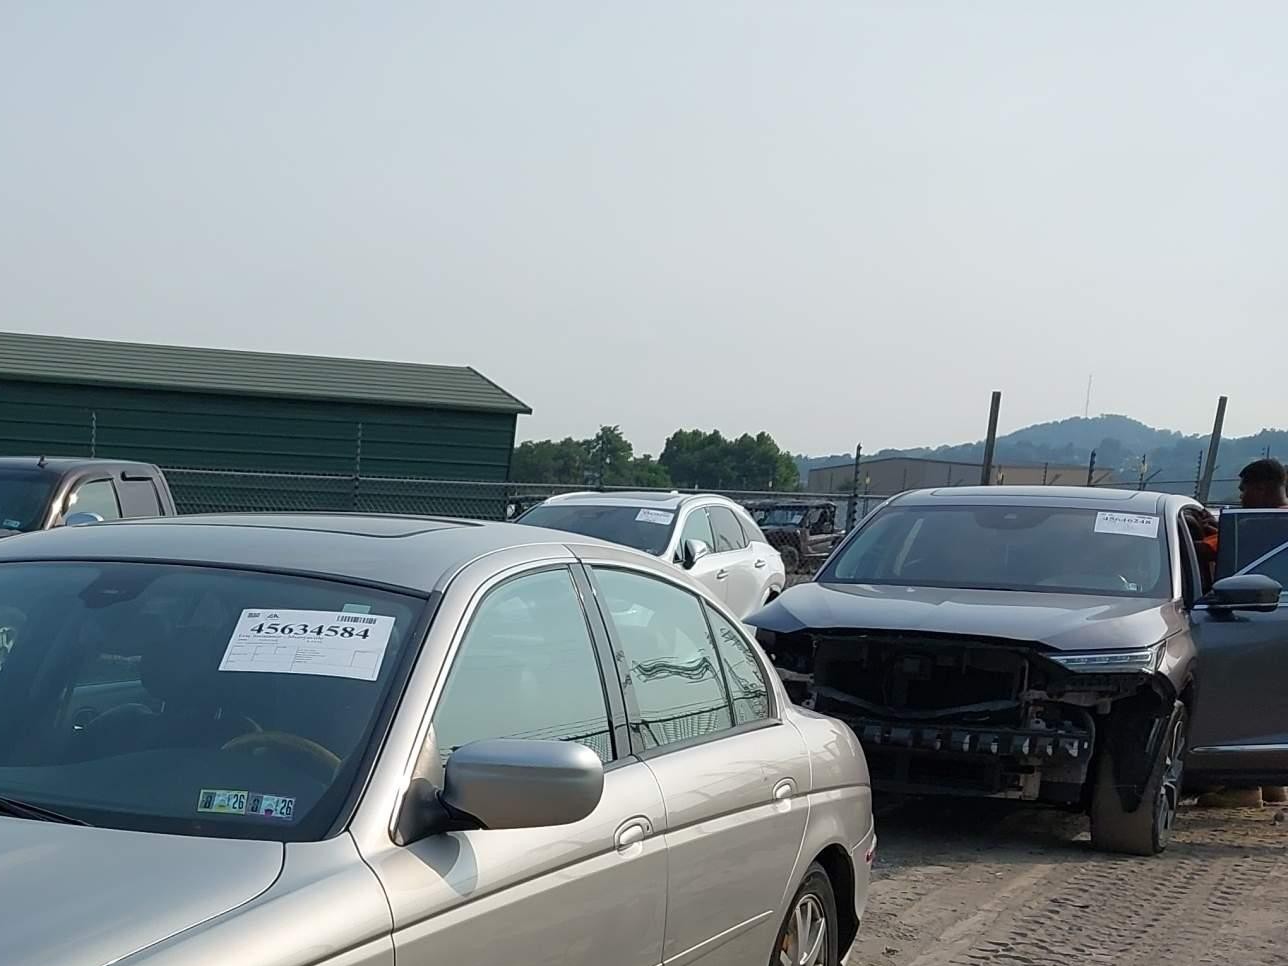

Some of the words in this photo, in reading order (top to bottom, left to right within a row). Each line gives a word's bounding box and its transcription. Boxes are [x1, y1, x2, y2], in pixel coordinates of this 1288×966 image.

[250, 623, 370, 640] 45634584
[232, 794, 245, 810] 26
[279, 799, 293, 816] 26
